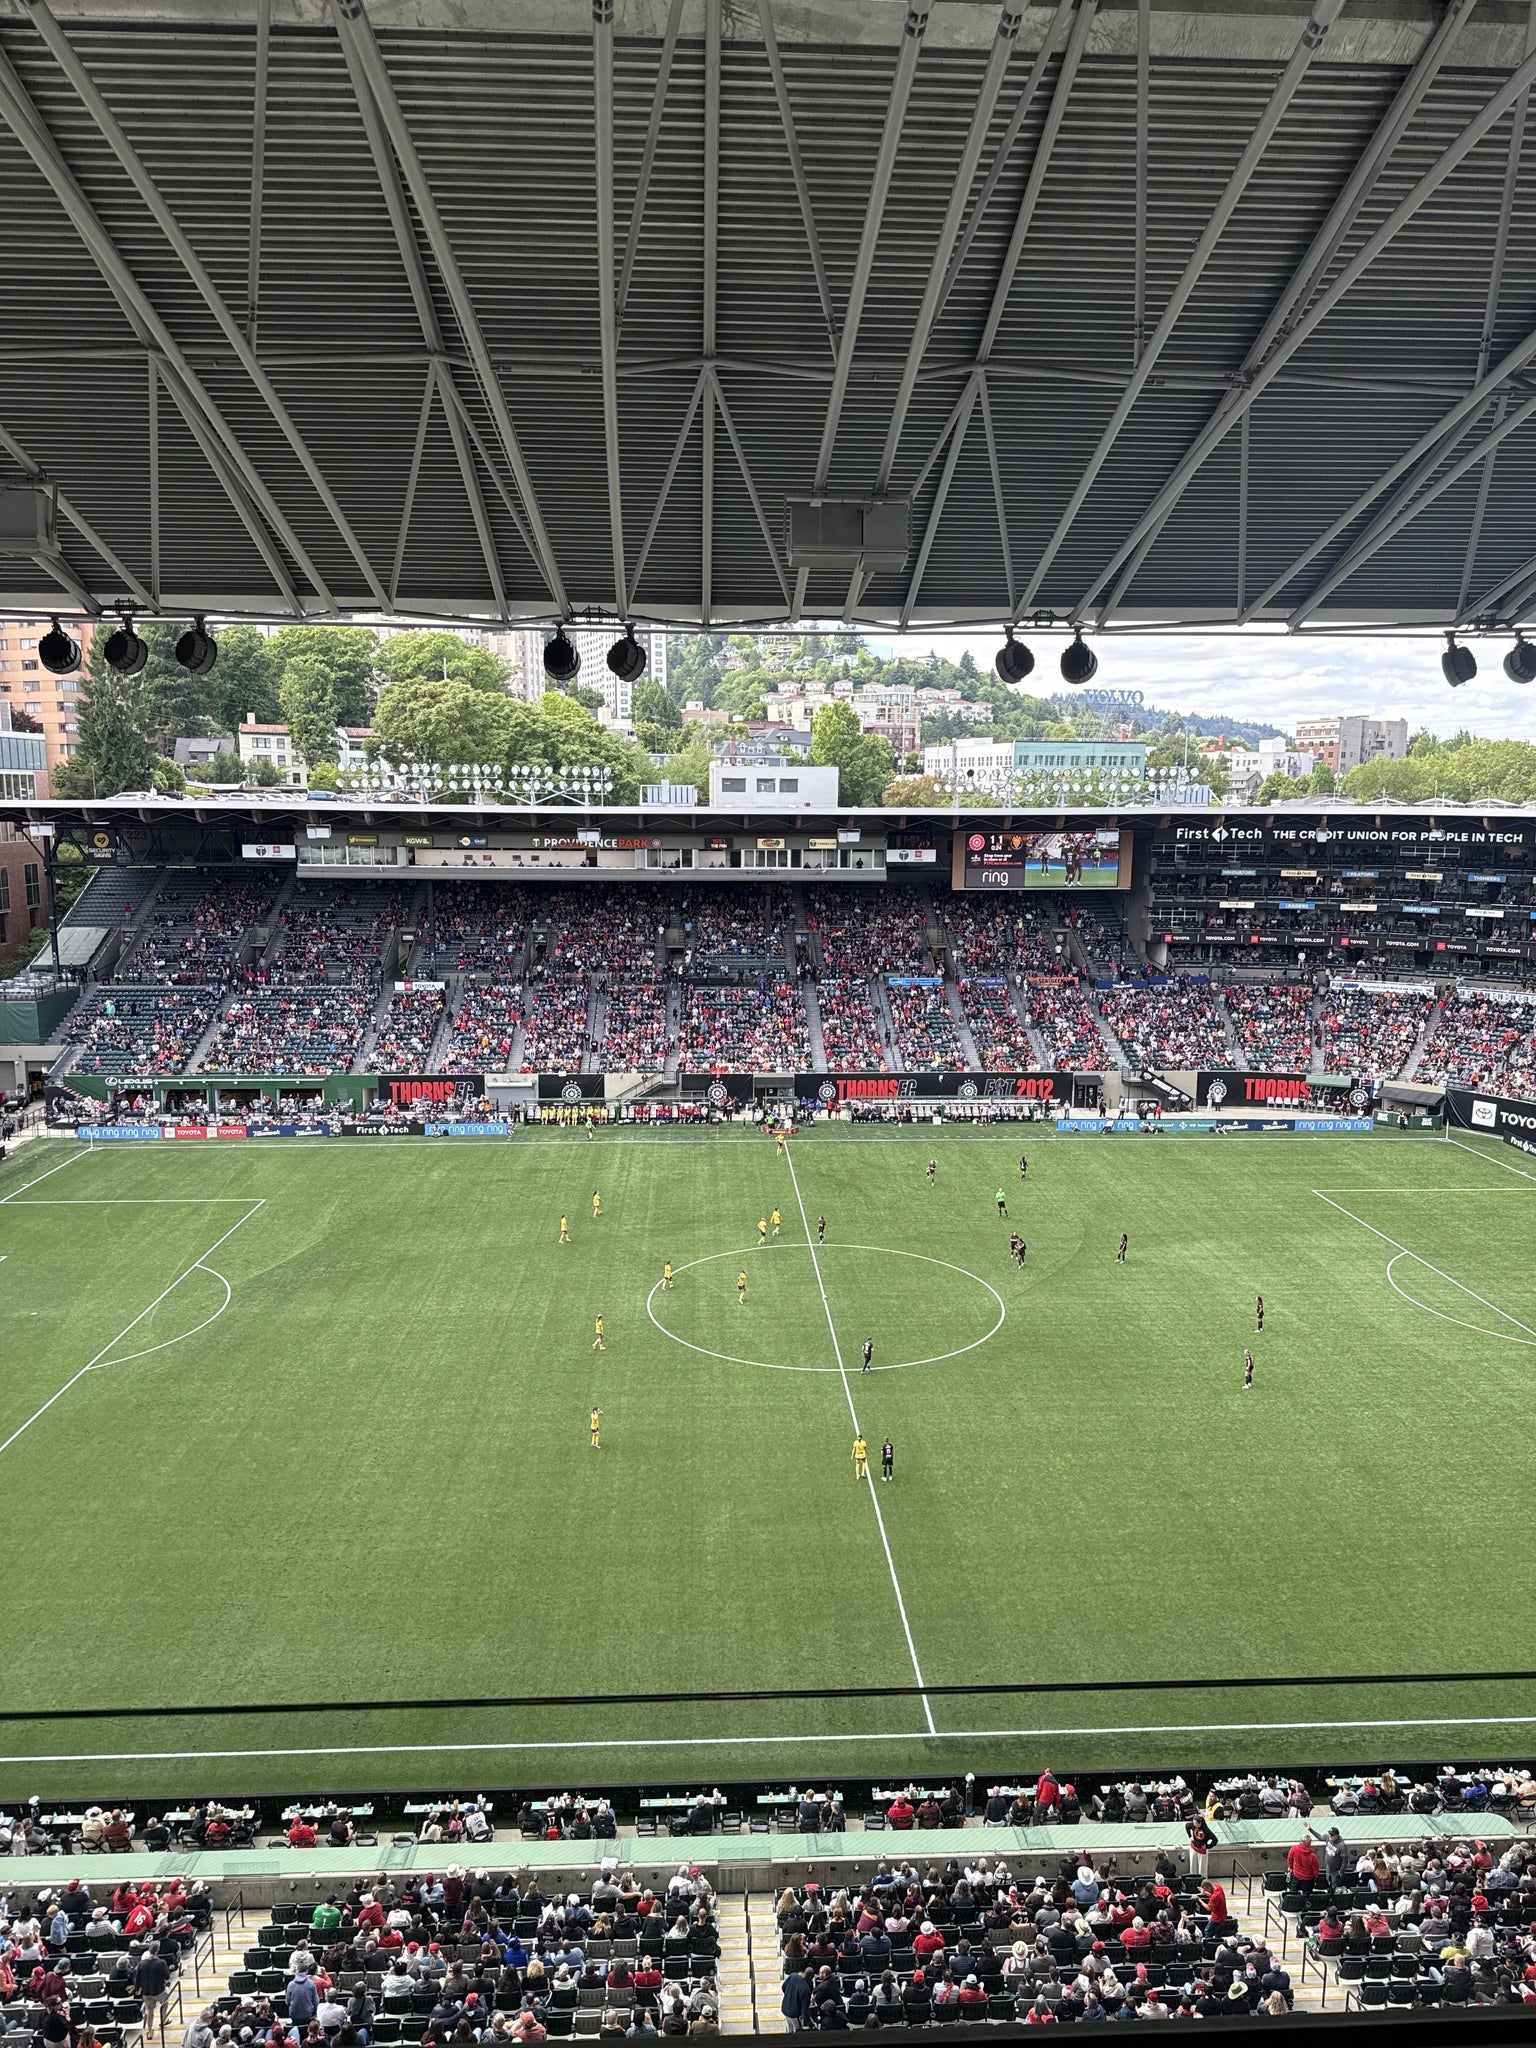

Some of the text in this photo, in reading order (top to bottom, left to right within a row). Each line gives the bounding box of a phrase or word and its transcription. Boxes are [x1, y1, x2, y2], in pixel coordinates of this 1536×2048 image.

[1083, 689, 1145, 704] VOLVO
[127, 830, 147, 840] 223
[1176, 828, 1262, 839] First Tech
[1273, 830, 1296, 840] THE
[1299, 830, 1345, 841] CRDIT
[1347, 831, 1390, 841] UNION
[1391, 831, 1416, 841] FOR
[1471, 832, 1484, 842] IN
[1487, 833, 1523, 843] TECH
[544, 838, 648, 848] PROVIDENCE PARK
[990, 835, 1003, 844] 1 1
[982, 869, 1008, 886] ring
[1486, 946, 1521, 954] TOYOTA.COM
[389, 1081, 475, 1104] THORNS FC
[836, 1078, 918, 1099] THORNS FC
[983, 1078, 1054, 1099] EST 2012
[1244, 1078, 1311, 1101] THORNS
[356, 1125, 409, 1134] First Tech
[448, 1125, 465, 1135] ring
[468, 1125, 484, 1135] ring
[487, 1124, 503, 1135] ring
[1062, 1121, 1078, 1130] ring
[1080, 1121, 1096, 1130] ring
[1118, 1121, 1133, 1130] ring
[1299, 1121, 1370, 1130] ring ring ring ring
[82, 1127, 158, 1138] ring ring ring ring
[1511, 1136, 1523, 1148] First
[547, 1817, 555, 1825] 17
[133, 1911, 146, 1925] 16
